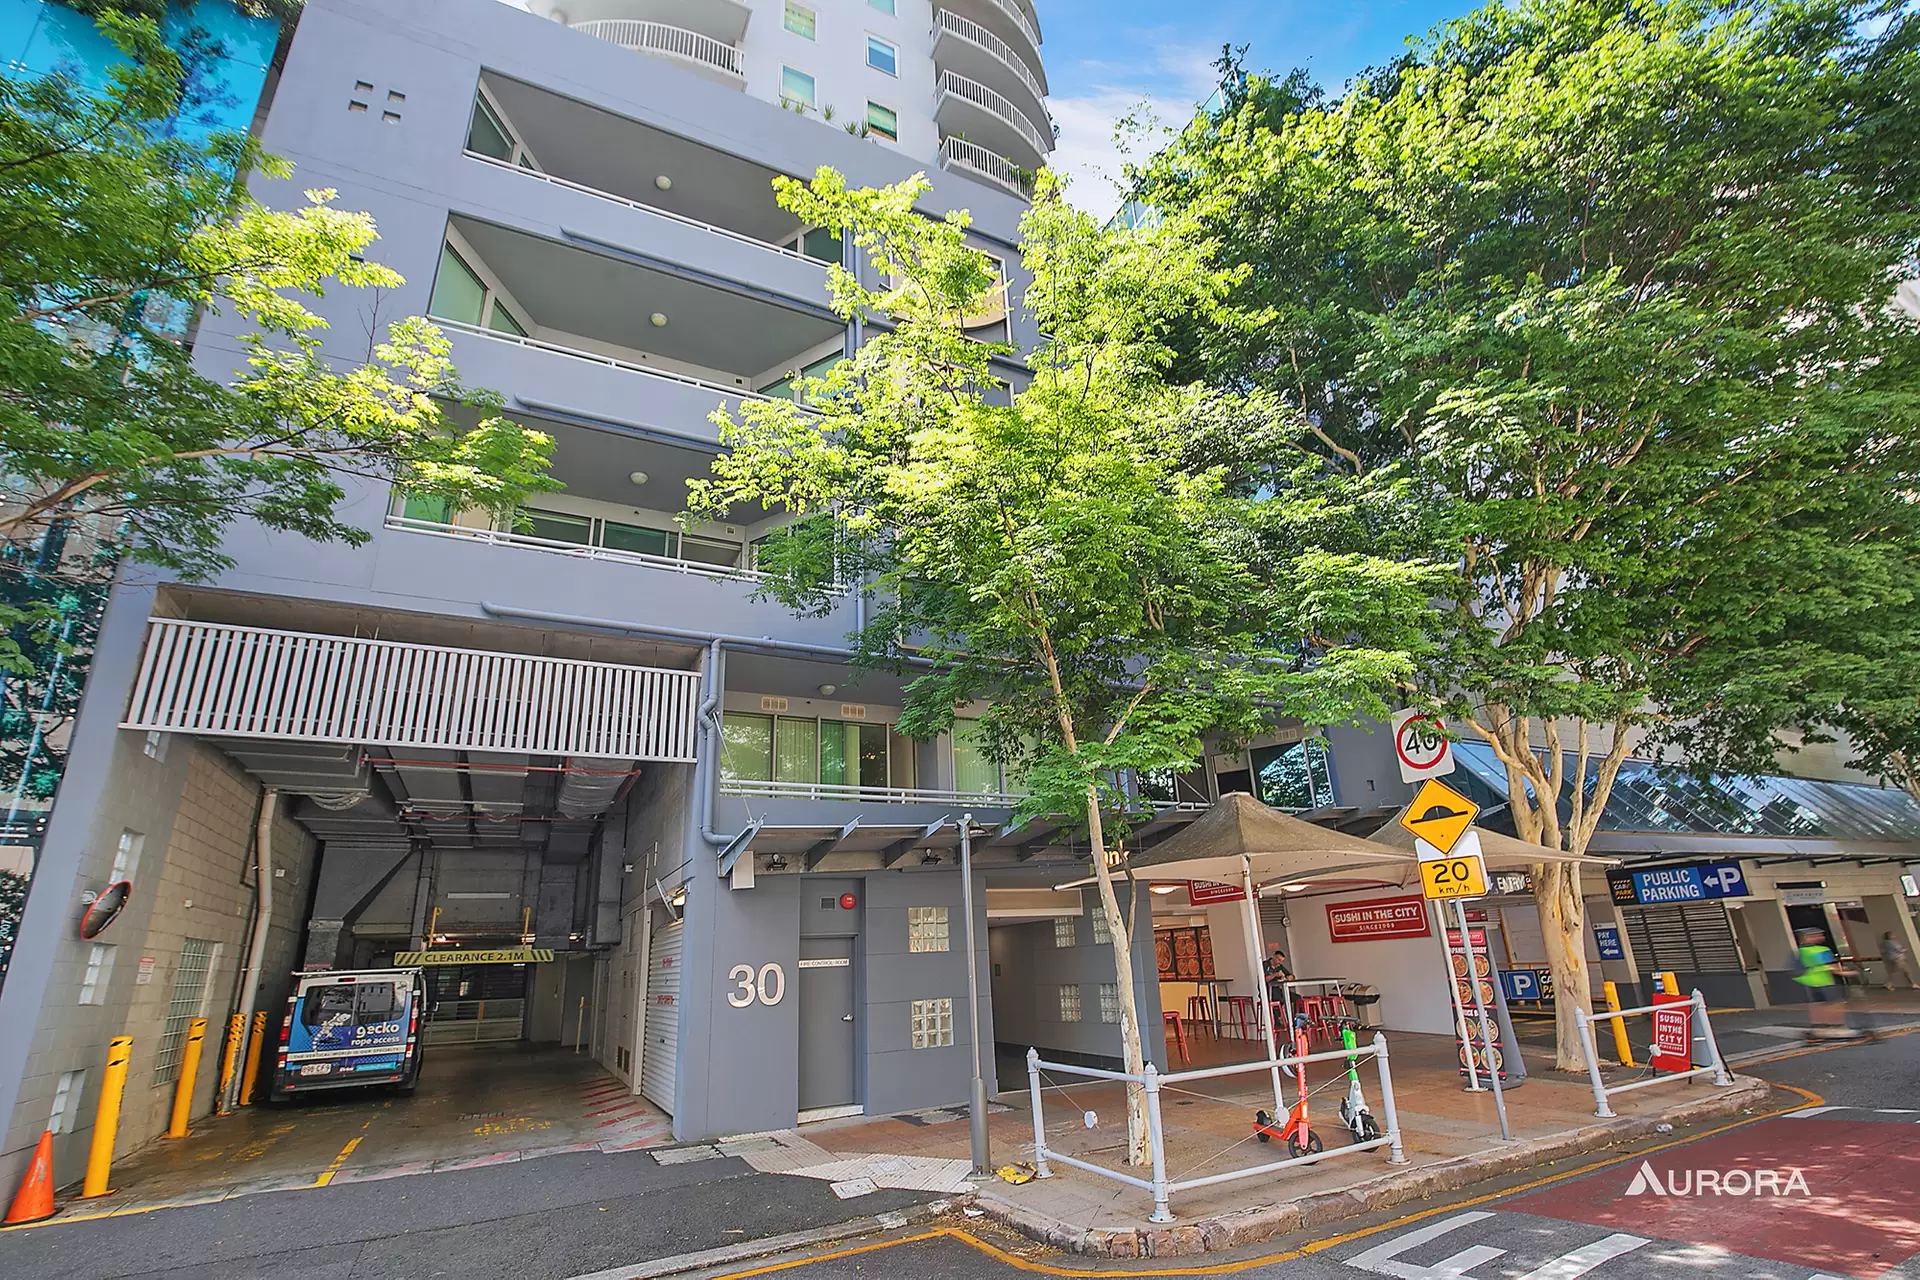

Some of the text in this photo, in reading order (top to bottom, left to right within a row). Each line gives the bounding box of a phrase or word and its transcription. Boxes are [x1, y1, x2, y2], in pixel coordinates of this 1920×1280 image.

[1432, 861, 1469, 884] 20
[1642, 869, 1691, 887] PUBLIC
[1717, 867, 1741, 893] P
[1438, 883, 1470, 894] km/h
[1641, 884, 1700, 901] PARKING
[1334, 906, 1417, 923] SUSHI IN THE CITY
[1598, 931, 1611, 939] PAY
[425, 952, 525, 963] CLEARANCE 2.1M
[727, 962, 786, 1008] 30
[1513, 975, 1532, 996] P
[1659, 1014, 1682, 1023] SUSHI
[356, 1021, 399, 1038] gecko
[351, 1036, 399, 1046] rope access
[1659, 1035, 1682, 1043] CITY
